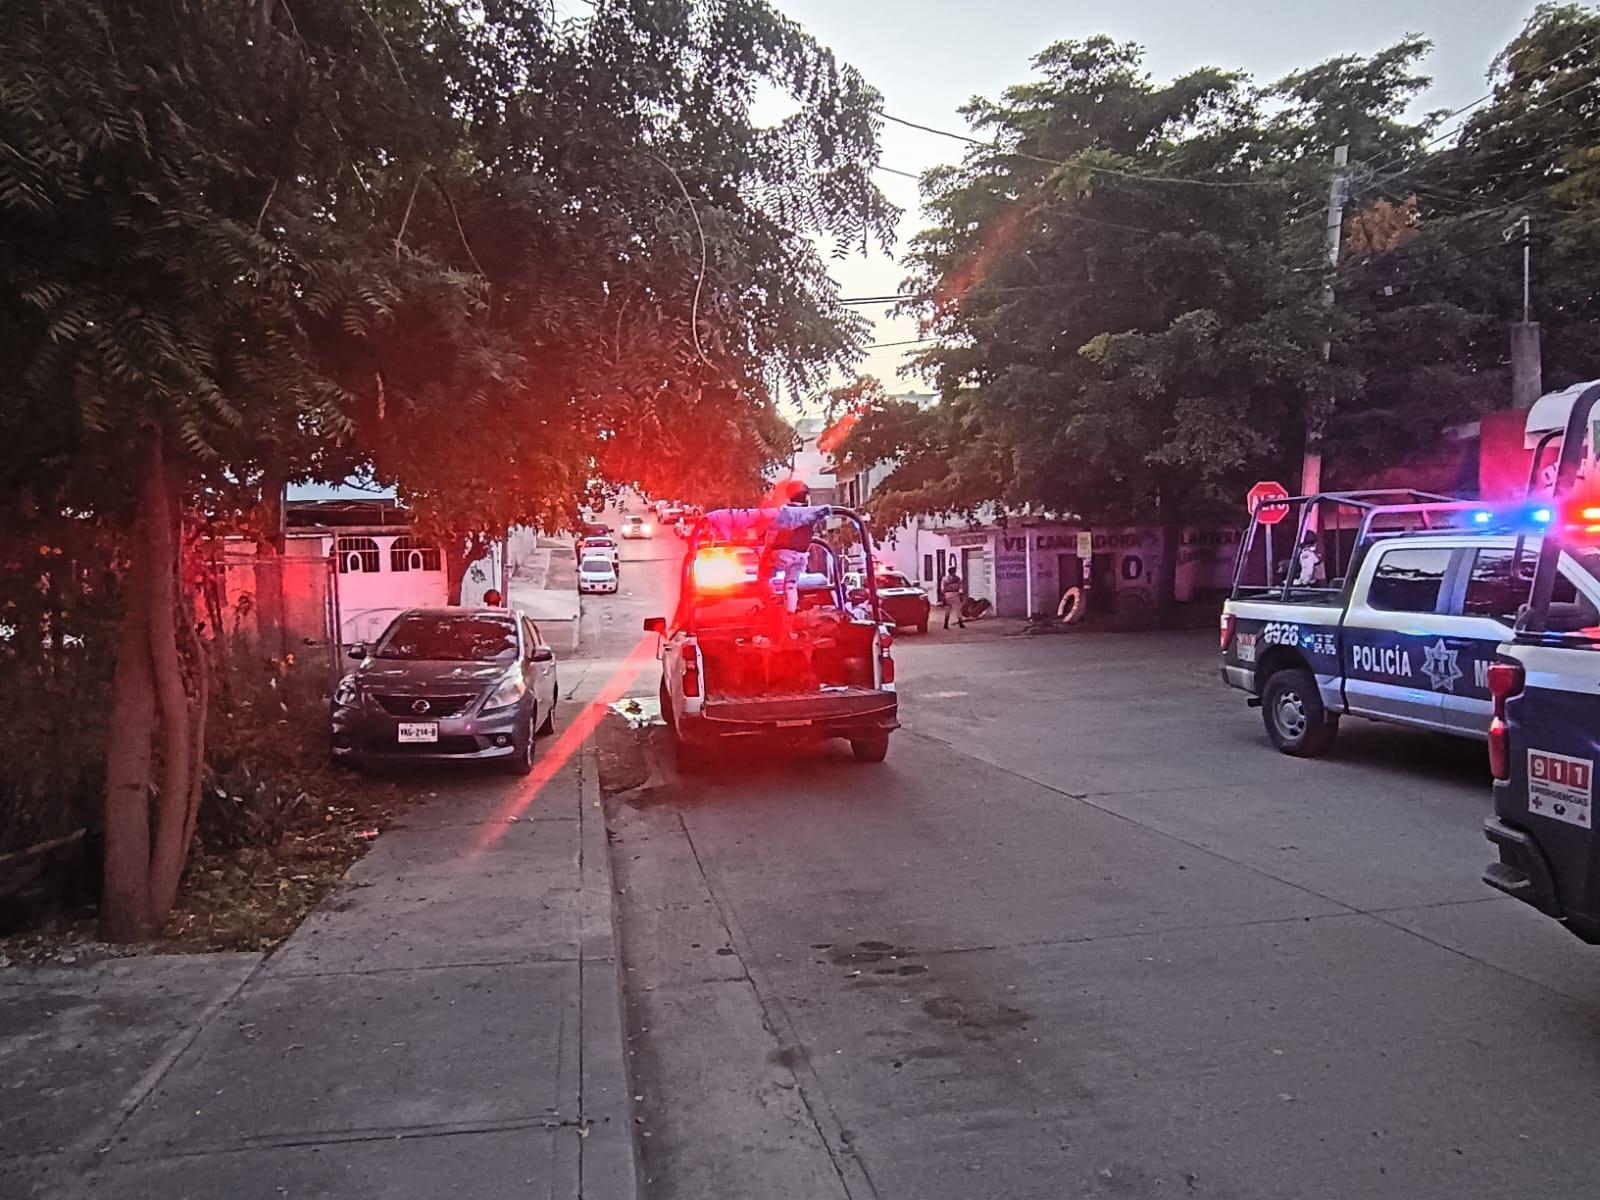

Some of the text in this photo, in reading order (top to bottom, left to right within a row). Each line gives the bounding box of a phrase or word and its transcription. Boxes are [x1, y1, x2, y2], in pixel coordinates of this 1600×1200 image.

[1252, 494, 1285, 511] ALTO
[1352, 644, 1412, 677] POLICÍA
[1534, 758, 1583, 785] 911
